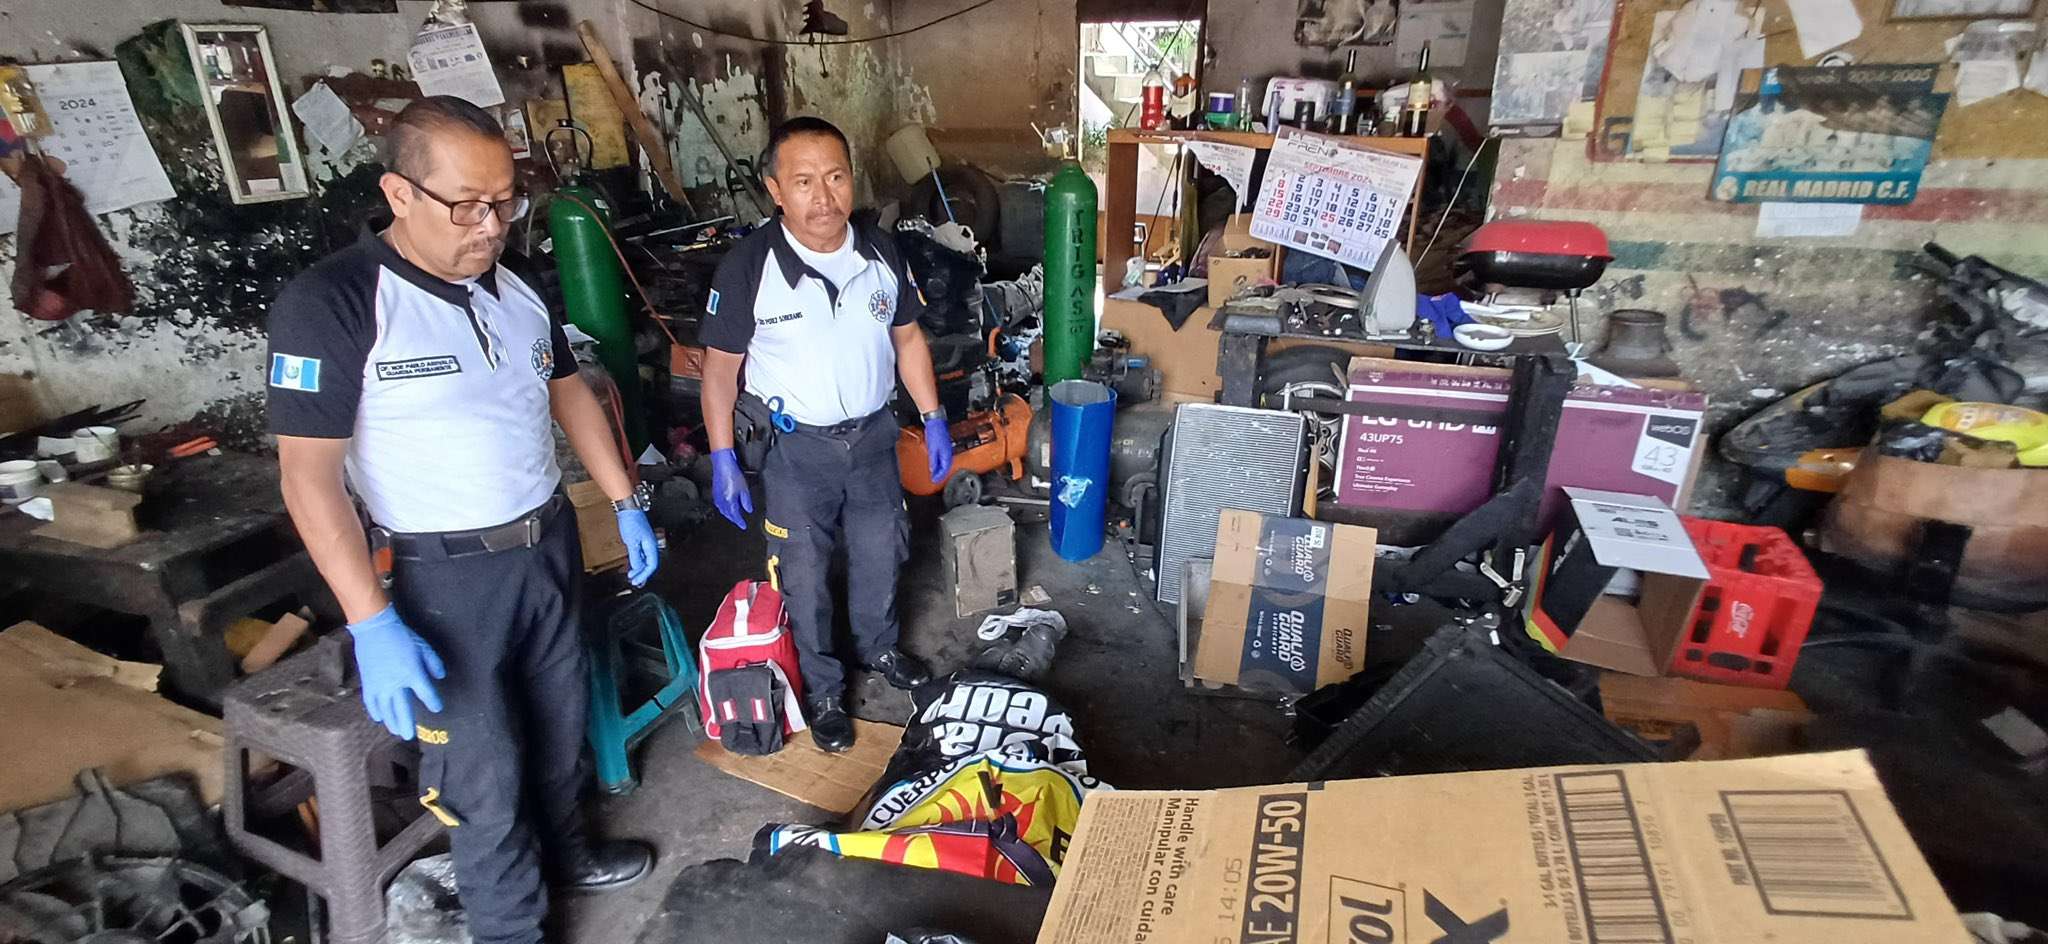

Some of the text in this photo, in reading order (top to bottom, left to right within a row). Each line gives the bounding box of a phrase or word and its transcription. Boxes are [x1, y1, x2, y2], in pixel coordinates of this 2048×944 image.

[60, 98, 96, 110] 2024
[1273, 189, 1391, 228] 15 16 17 18 19 20 18
[1277, 179, 1393, 218] 8 9 10 11 12 13 11
[1316, 178, 1323, 187] 3
[1335, 183, 1342, 191] 4
[1352, 188, 1360, 197] 5
[1370, 193, 1377, 201] 6
[1389, 199, 1397, 207] 4
[1743, 180, 1909, 199] REAL MADRID C.F.
[1265, 207, 1313, 227] 29 30 31
[1268, 199, 1389, 238] 22 23 24 25 26 27 25
[1359, 433, 1404, 444] 43UP75
[1651, 424, 1691, 435] webOS
[1644, 446, 1678, 466] 43
[1295, 535, 1304, 575] GUARD
[1278, 612, 1290, 662] GUARD
[1335, 629, 1344, 663] GUARD
[1177, 797, 1199, 843] Handle
[1135, 797, 1182, 944] Manipular con cuida
[1250, 800, 1302, 913] 20W-50
[1161, 883, 1178, 916] care
[1217, 857, 1242, 922] 14:05
[1560, 891, 1583, 941] BOTELLAS
